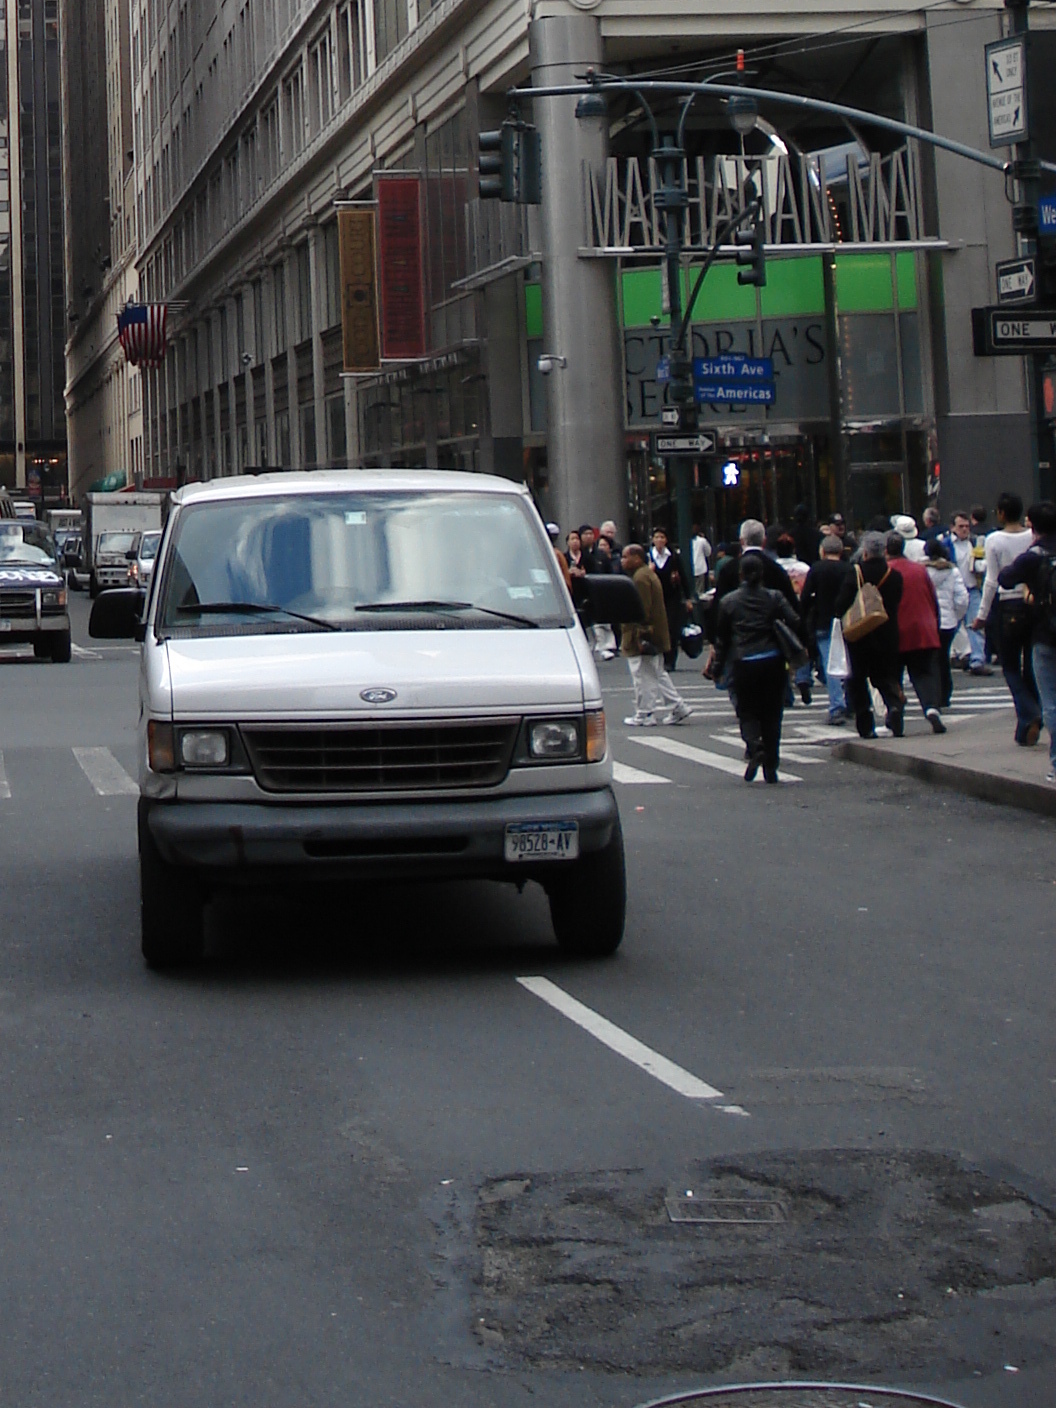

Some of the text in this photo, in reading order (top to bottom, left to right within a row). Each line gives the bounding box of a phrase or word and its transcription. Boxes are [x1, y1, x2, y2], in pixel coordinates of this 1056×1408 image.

[1001, 273, 1029, 291] ONE WAY
[1001, 323, 1030, 336] ONE
[702, 362, 764, 375] Sixth Ave
[716, 386, 772, 399] Americas
[660, 439, 705, 447] ONE WAY
